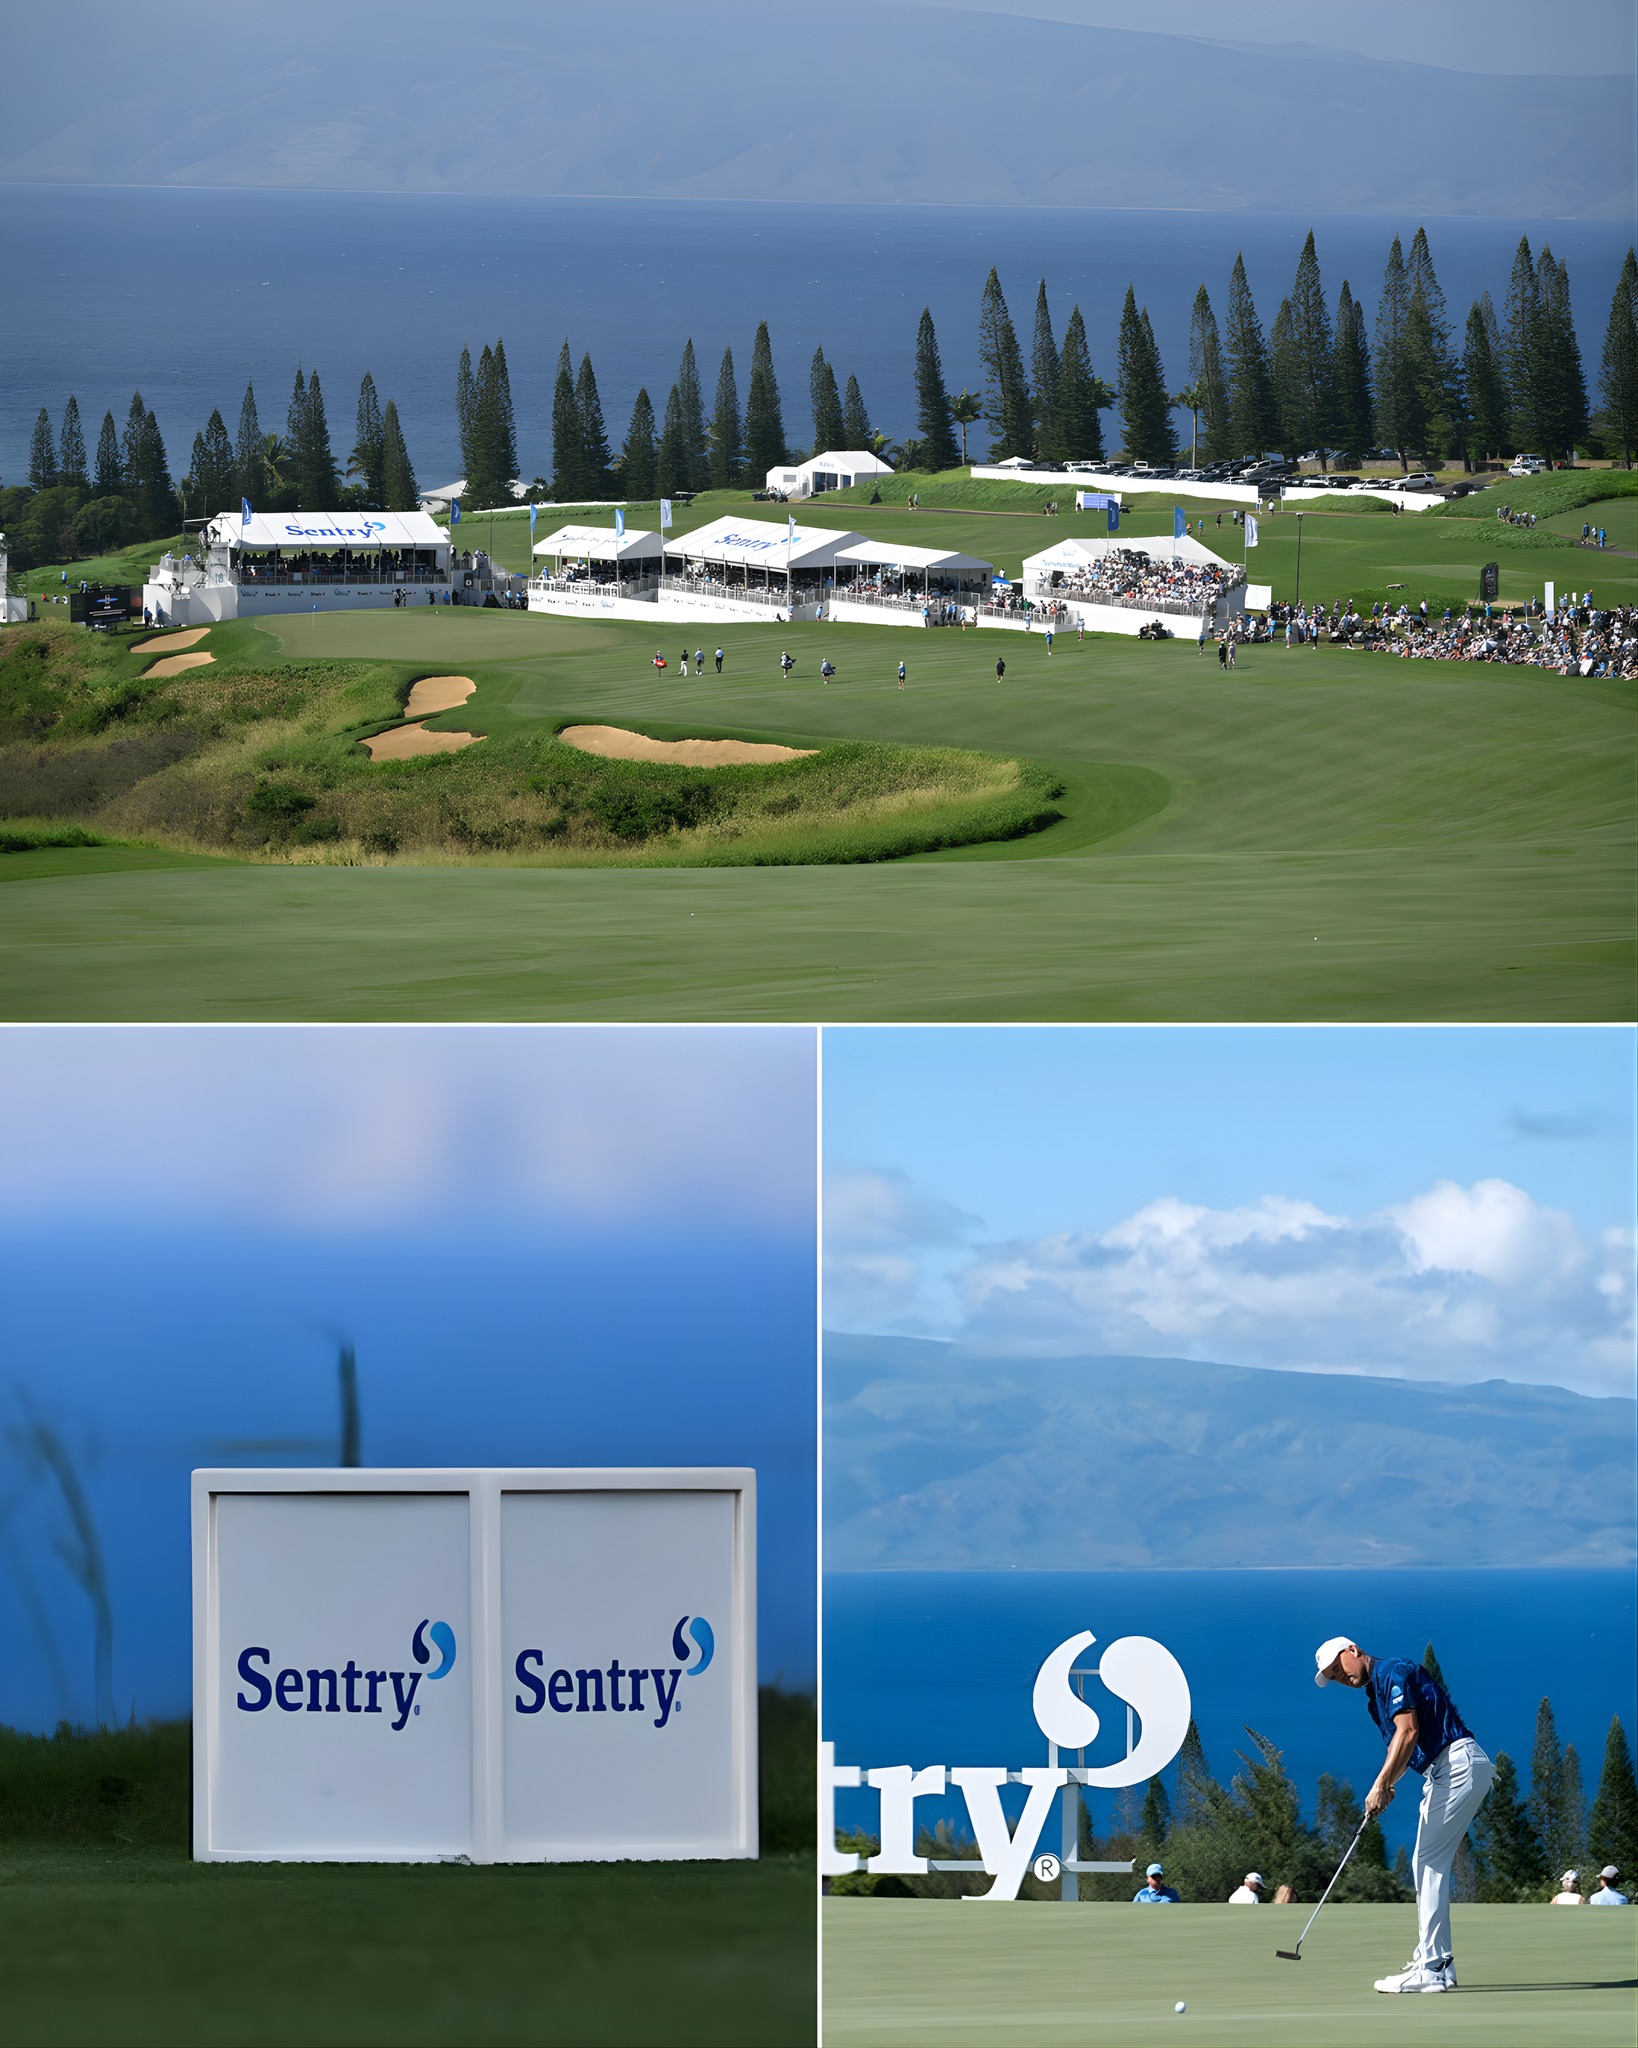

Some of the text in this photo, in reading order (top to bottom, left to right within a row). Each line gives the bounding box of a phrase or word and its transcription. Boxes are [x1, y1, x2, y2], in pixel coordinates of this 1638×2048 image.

[285, 525, 372, 539] Sentry
[714, 534, 777, 552] Sentry
[236, 1646, 423, 1732] Sentry
[515, 1649, 682, 1729] Sentry
